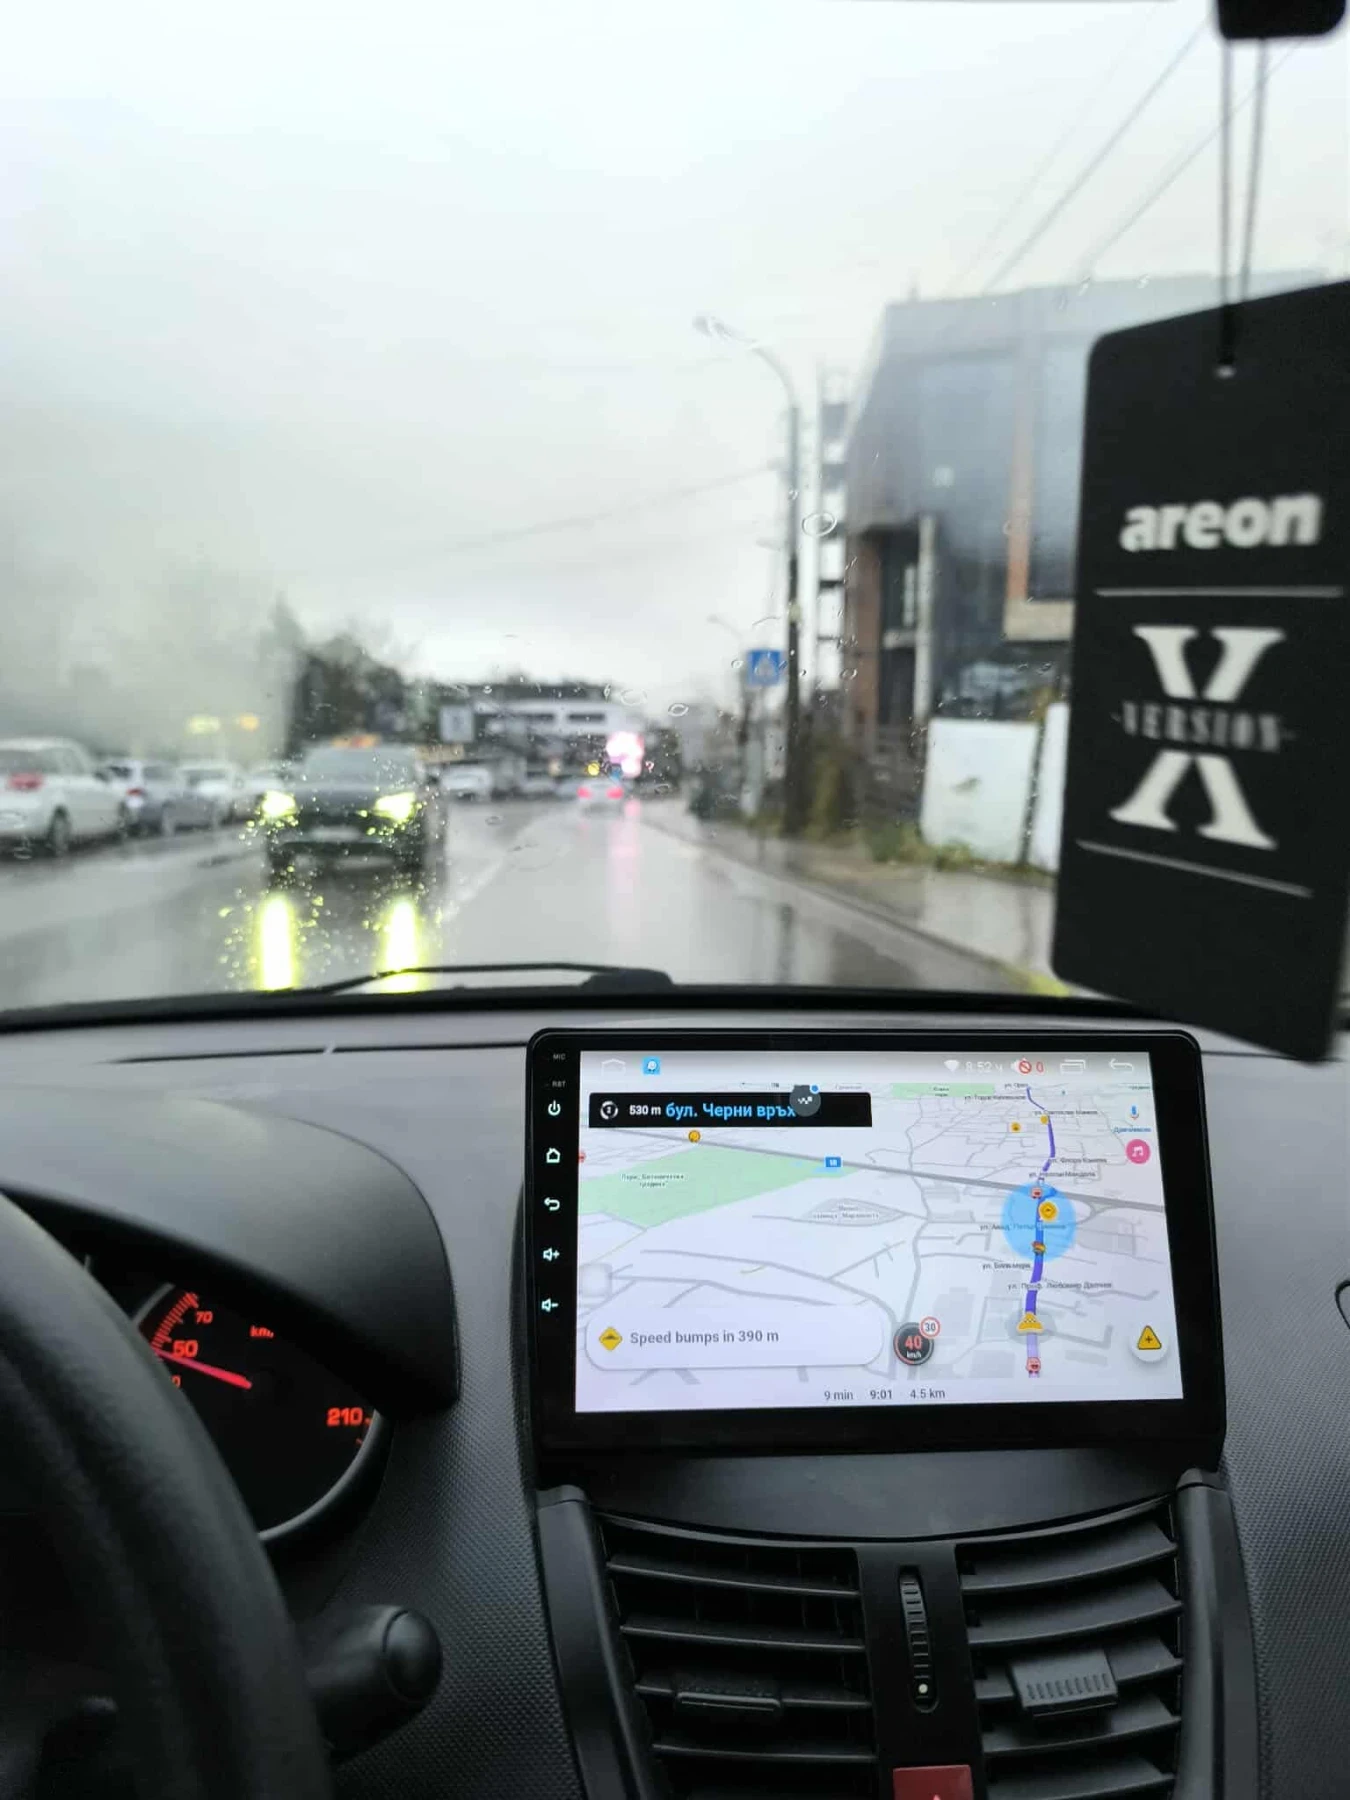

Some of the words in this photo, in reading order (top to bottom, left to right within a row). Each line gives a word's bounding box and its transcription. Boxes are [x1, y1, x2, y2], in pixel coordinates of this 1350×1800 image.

[1119, 493, 1322, 552] areon
[629, 1104, 649, 1116] 530
[651, 1106, 662, 1116] m
[665, 1102, 698, 1120] бул.
[702, 1103, 752, 1120] Черни
[756, 1105, 796, 1120] връх
[196, 1311, 213, 1324] 70
[925, 1322, 936, 1332] 30
[630, 1332, 672, 1347] Speed
[675, 1331, 720, 1347] bumps
[723, 1330, 735, 1343] in
[738, 1330, 763, 1343] 390
[766, 1332, 779, 1343] m
[905, 1336, 922, 1350] 40
[824, 1390, 831, 1400] 9
[833, 1389, 853, 1400] min
[869, 1389, 893, 1400] 9:01
[910, 1388, 927, 1399] 4.5
[929, 1388, 946, 1399] km
[327, 1406, 363, 1426] 210
